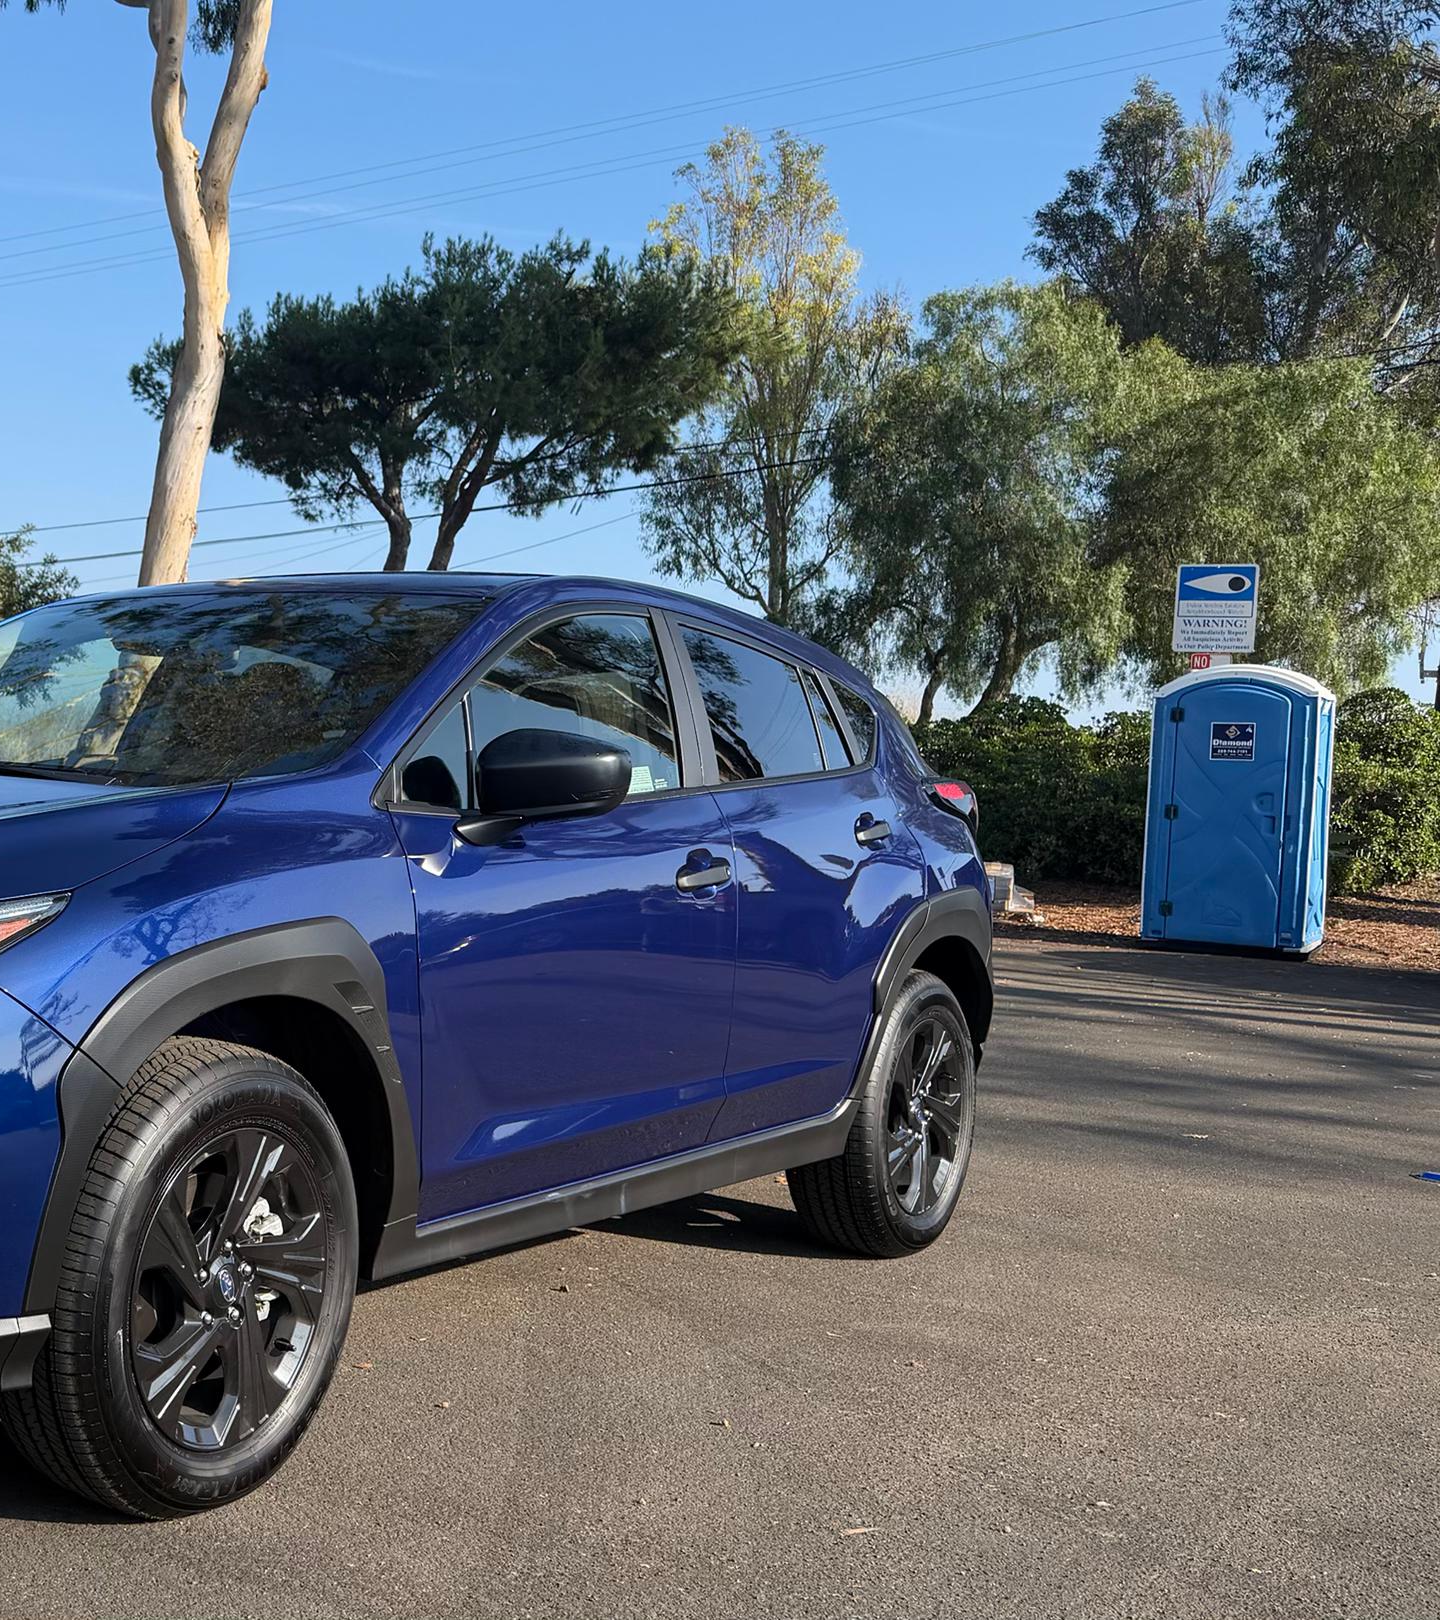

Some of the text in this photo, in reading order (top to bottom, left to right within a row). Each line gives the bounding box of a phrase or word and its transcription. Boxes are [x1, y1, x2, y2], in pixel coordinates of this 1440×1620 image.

[1182, 619, 1248, 628] WARNING!
[1193, 656, 1208, 667] NO
[1212, 738, 1253, 746] Diamond
